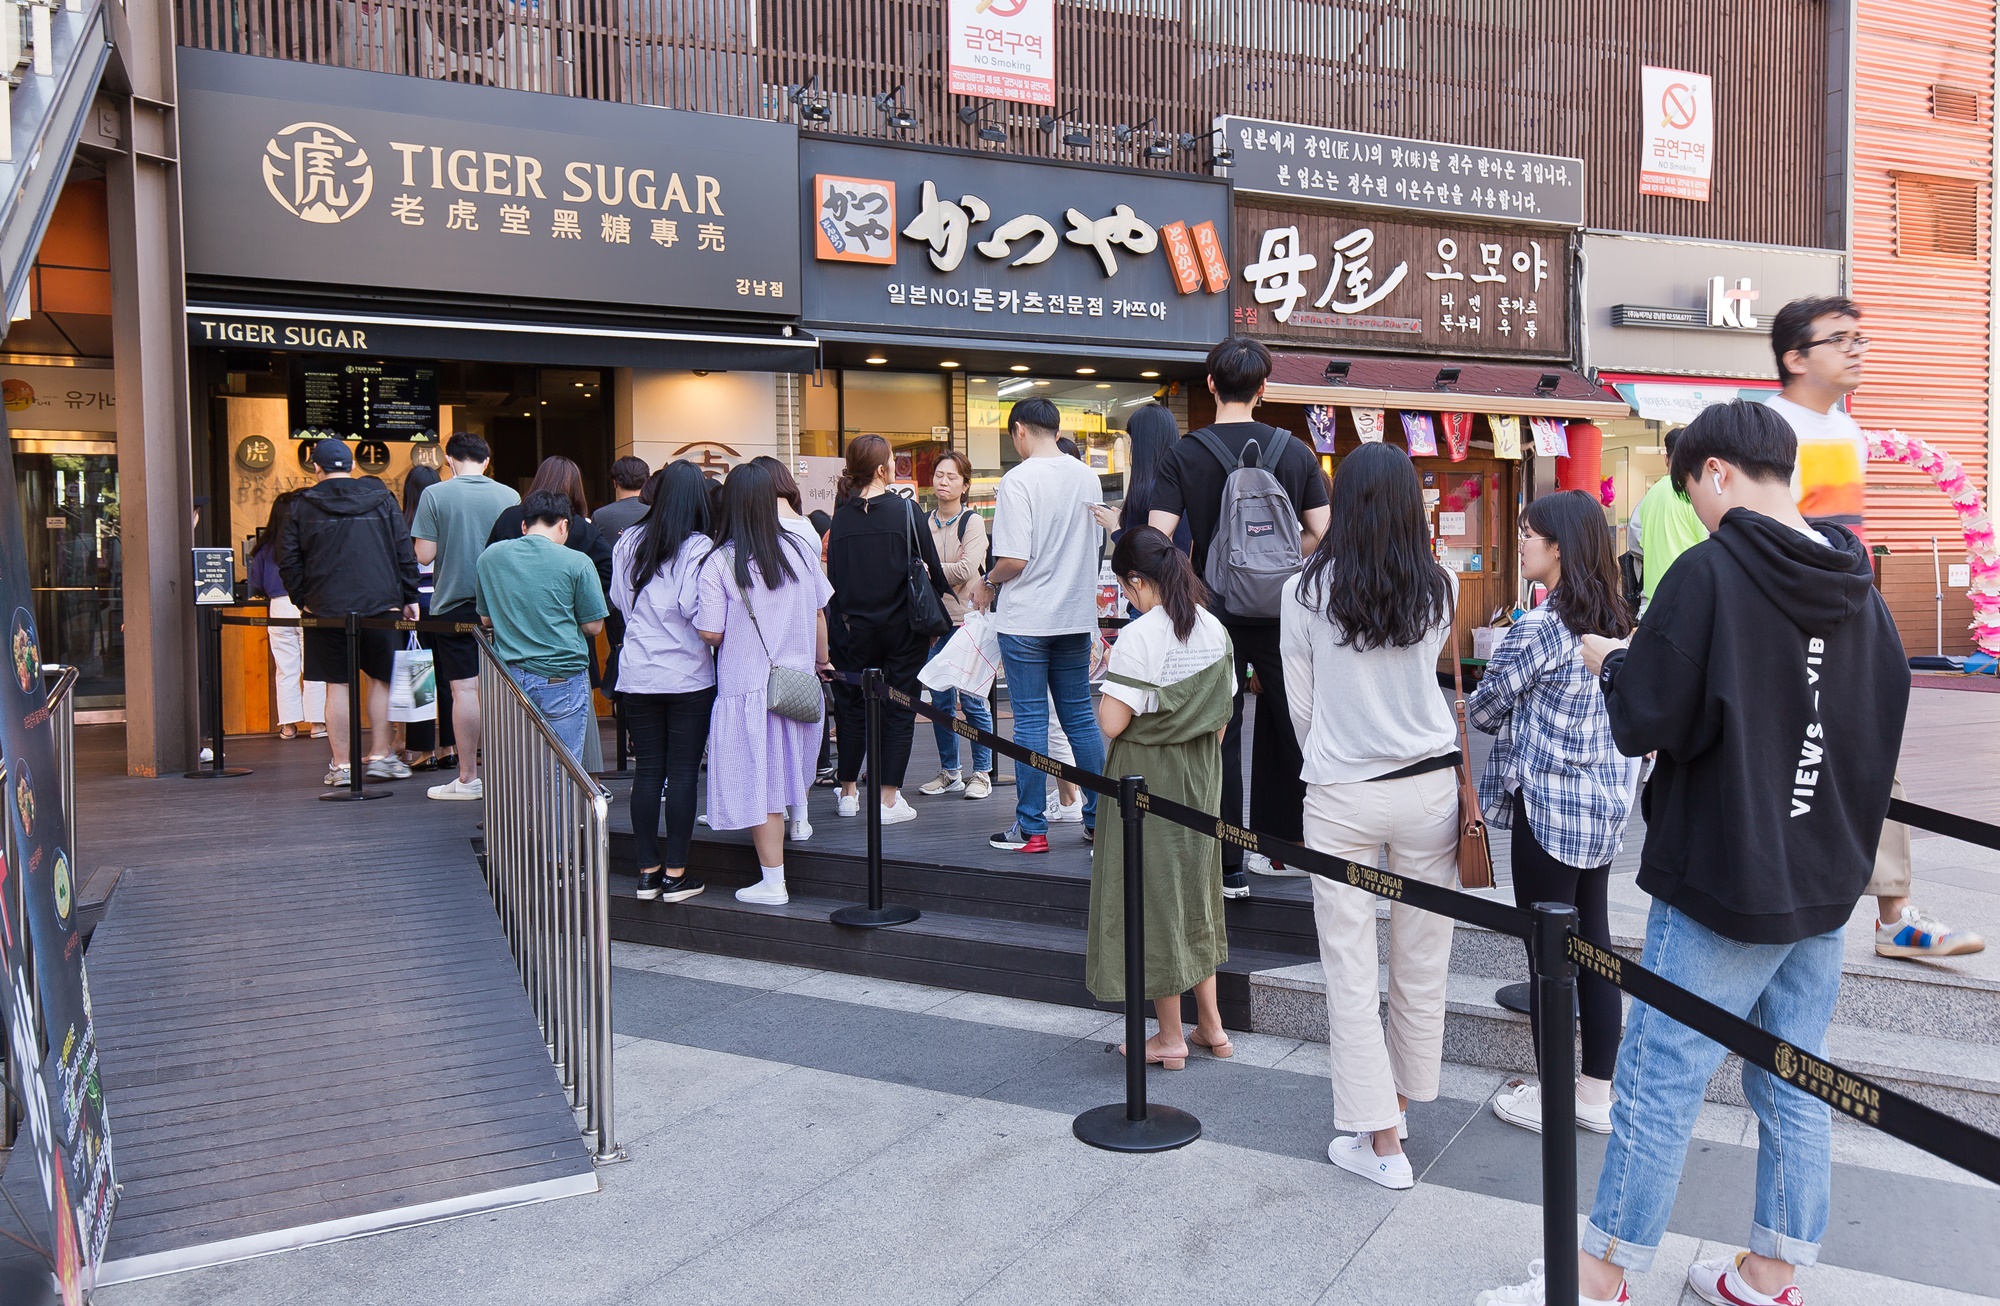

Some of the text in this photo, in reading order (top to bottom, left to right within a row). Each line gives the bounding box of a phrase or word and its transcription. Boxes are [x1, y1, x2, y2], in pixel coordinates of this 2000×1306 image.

[964, 25, 1042, 59] 금연구역
[974, 54, 1031, 73] NO Smoking
[1240, 127, 1573, 188] 일본에서 장인(匠人)의 맛(味)을 전수 받아온 집입니다.
[1652, 137, 1706, 163] 금연구역
[1658, 160, 1697, 174] NO Smoking
[390, 141, 725, 218] TIGER SUGAR
[1278, 165, 1543, 215] 본 업소는 정수된 이온수만을 사용합니다.
[901, 180, 1159, 278] かつや
[1168, 226, 1197, 284] とんかつ
[1200, 228, 1225, 282] カツ丼
[1426, 237, 1549, 293] 오모야
[735, 278, 784, 298] 강남점
[1244, 225, 1409, 324] 母屋
[1112, 298, 1167, 321] 카쯔야
[1498, 296, 1539, 316] 돈까츠
[1706, 276, 1761, 329] kt
[201, 321, 368, 350] TIGER SUGAR
[1440, 314, 1481, 334] 돈부리
[1452, 412, 1464, 454] ラーメン
[246, 441, 270, 463] 虎
[362, 444, 384, 466] 生
[1790, 722, 1825, 818] VIEWS
[1225, 824, 1258, 845] TIGER SUGAR
[1360, 867, 1403, 891] TIGER SUGAR
[1572, 936, 1622, 974] TIGER SUGAR
[1799, 1054, 1880, 1110] TIGER SUGAR
